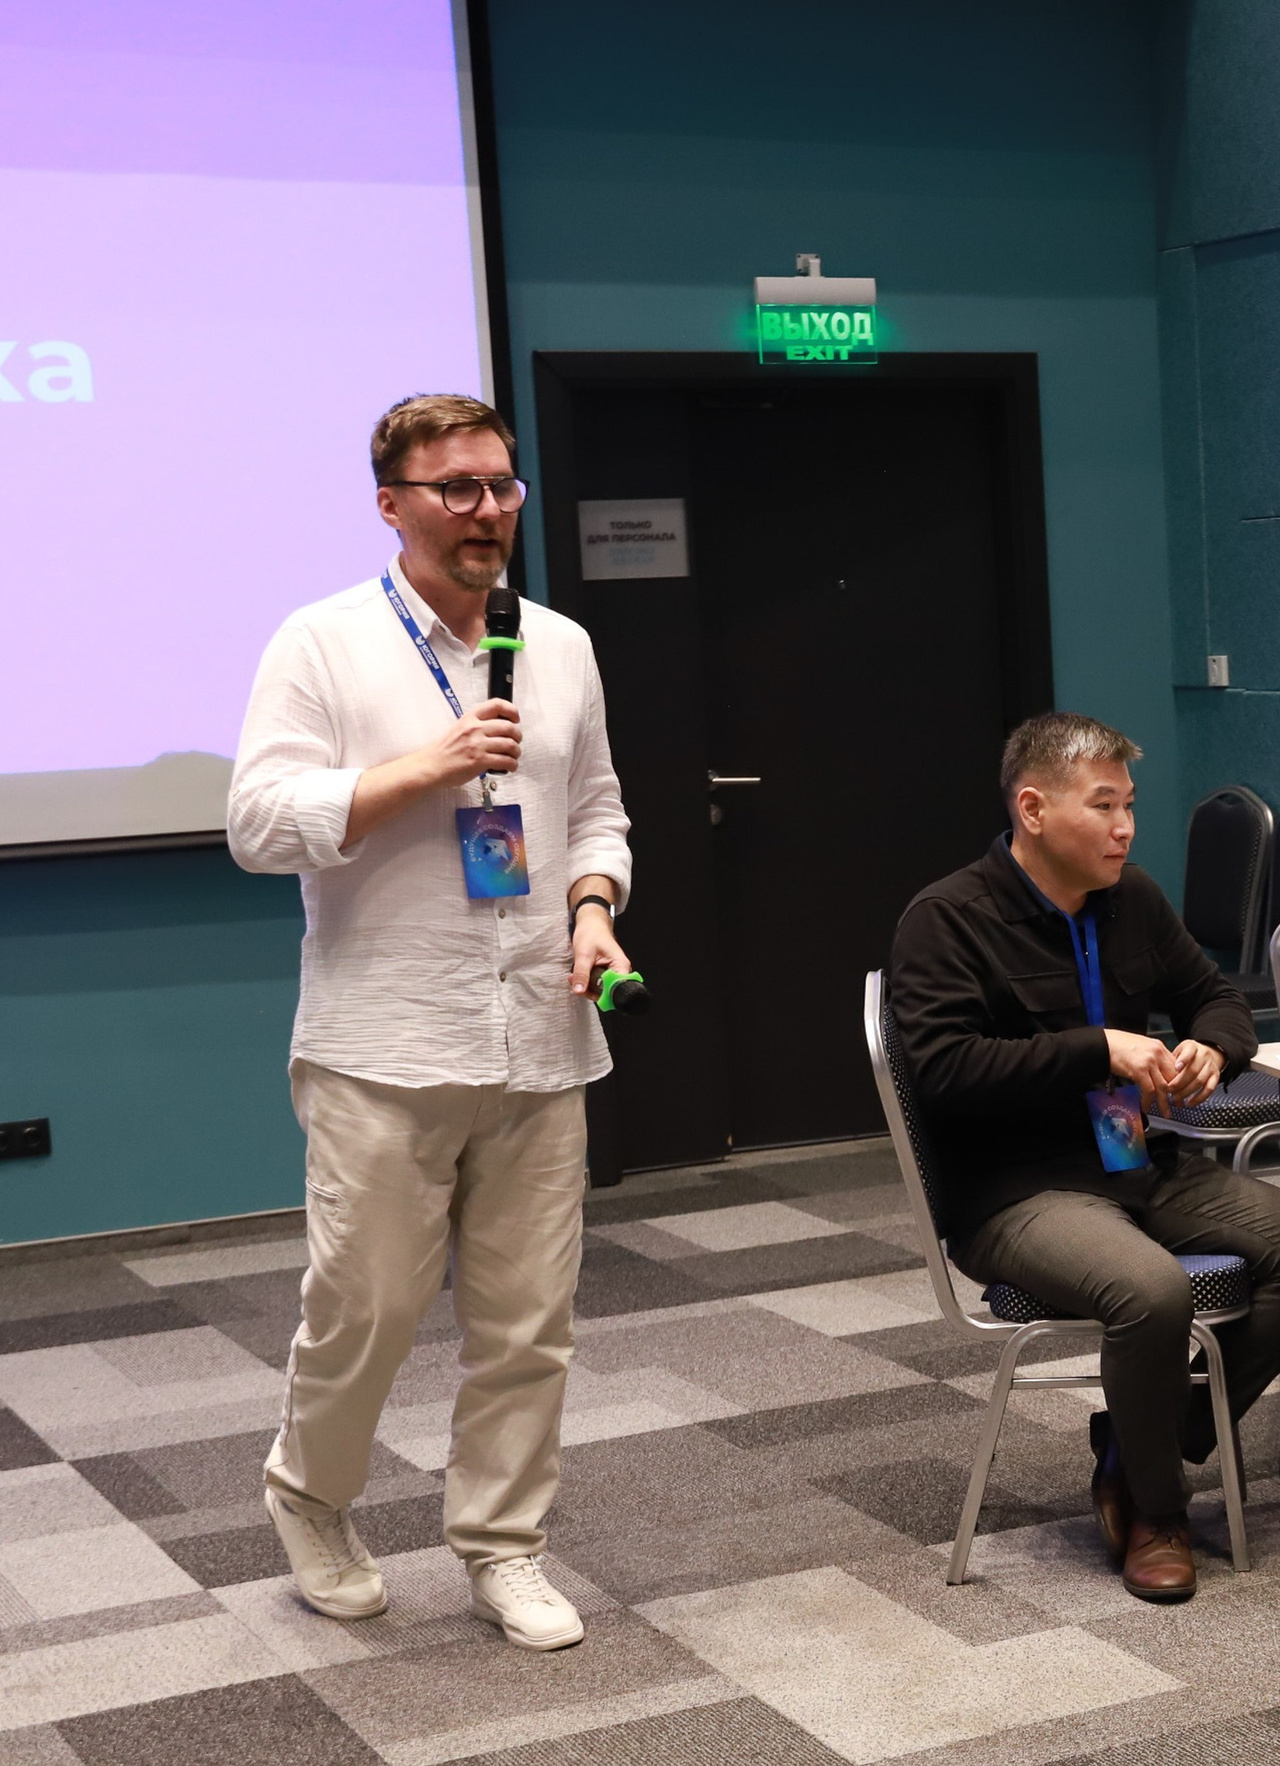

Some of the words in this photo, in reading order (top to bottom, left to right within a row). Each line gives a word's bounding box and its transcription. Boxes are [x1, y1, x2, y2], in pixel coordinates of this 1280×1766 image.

[762, 312, 874, 345] ВЫХОД
[786, 345, 852, 361] EXIT
[610, 520, 652, 530] ТОЛЬКО
[587, 534, 609, 545] ДЛЯ
[611, 532, 676, 543] ПЕРСОНАЛА
[422, 645, 440, 670] ЮГОРИЯ
